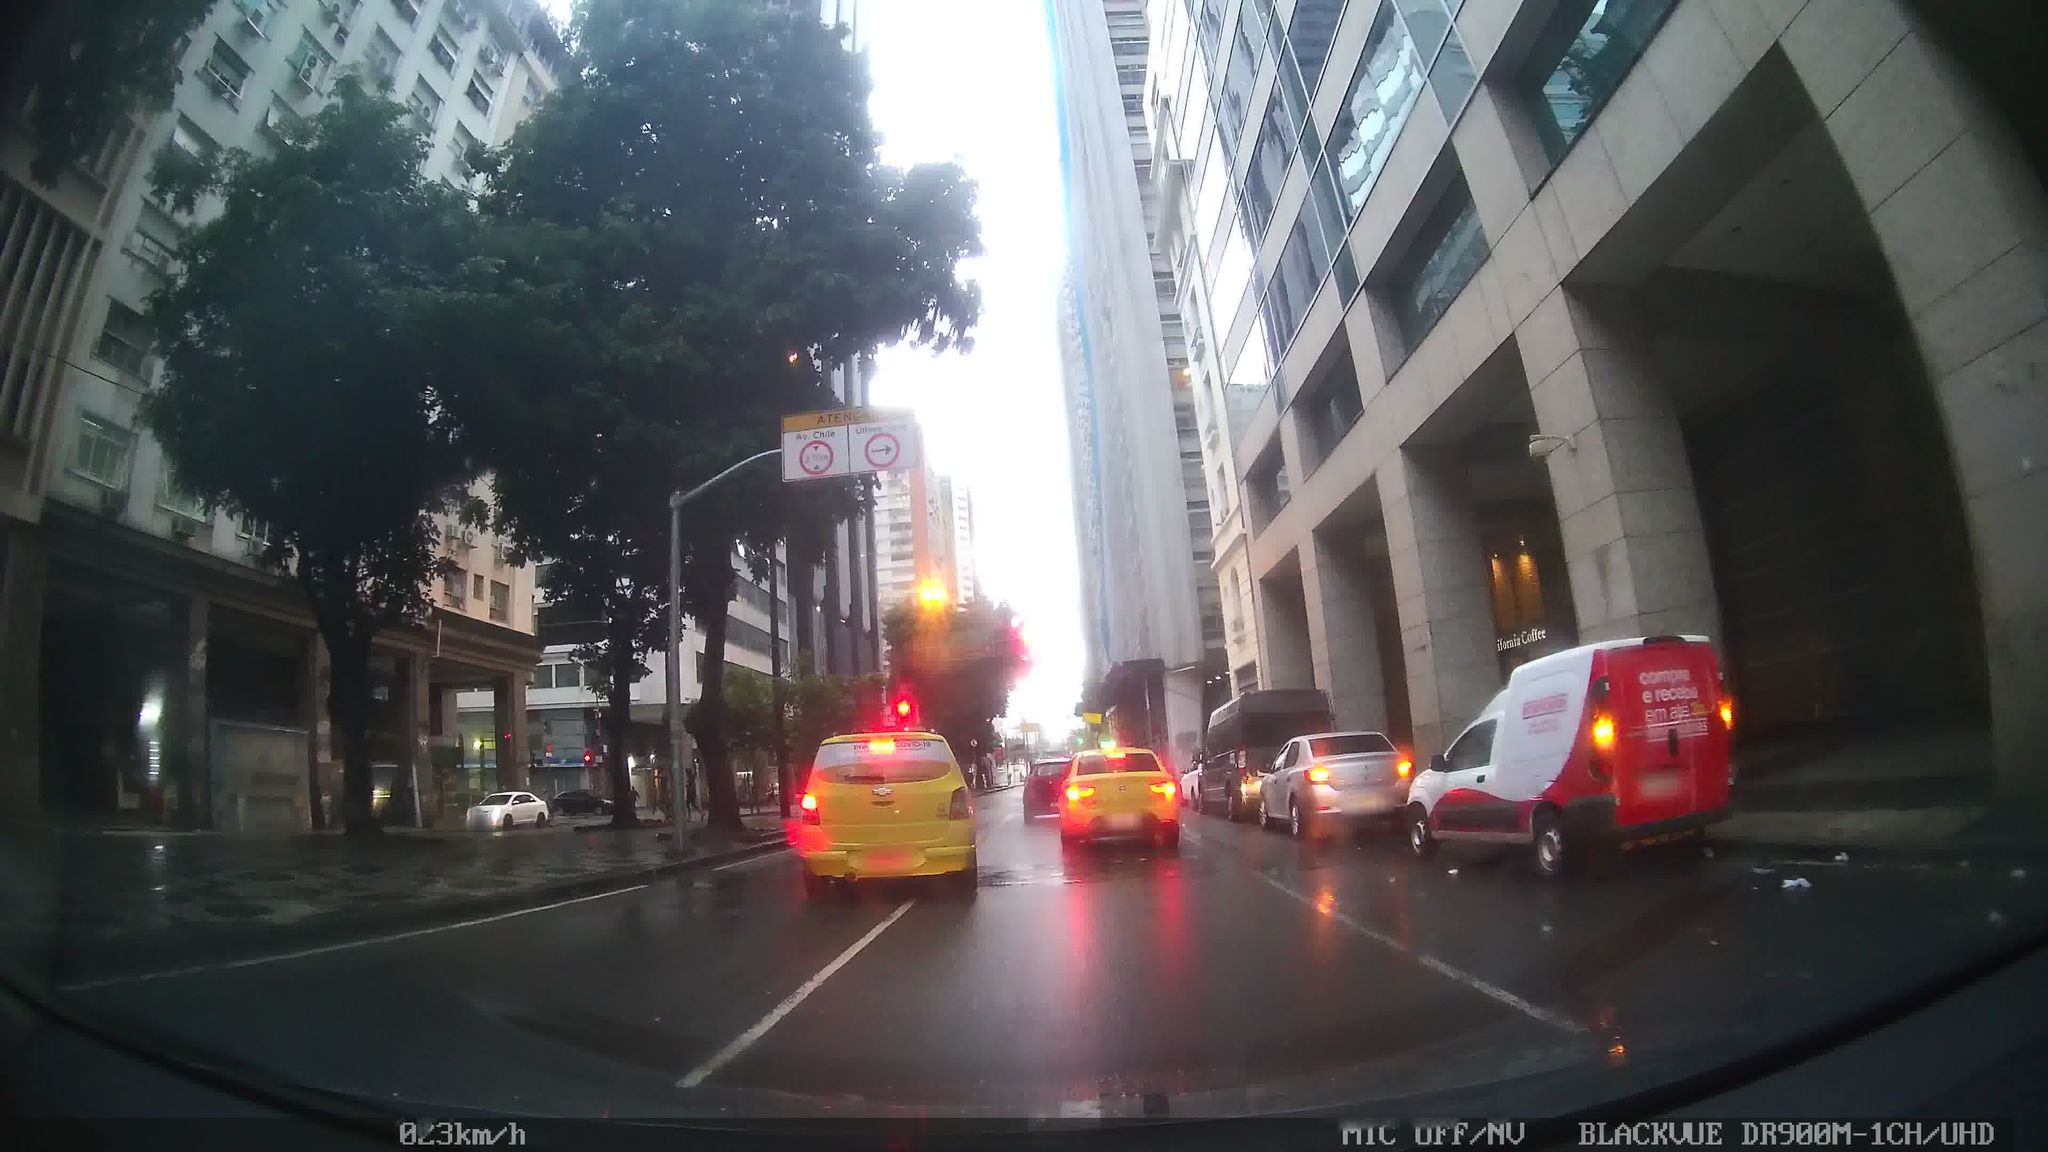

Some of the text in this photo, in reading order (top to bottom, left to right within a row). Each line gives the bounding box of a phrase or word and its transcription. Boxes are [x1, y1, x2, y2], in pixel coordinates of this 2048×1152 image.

[813, 430, 836, 439] Chile
[1496, 628, 1547, 652] ifornia Coffee
[1642, 690, 1653, 704] e
